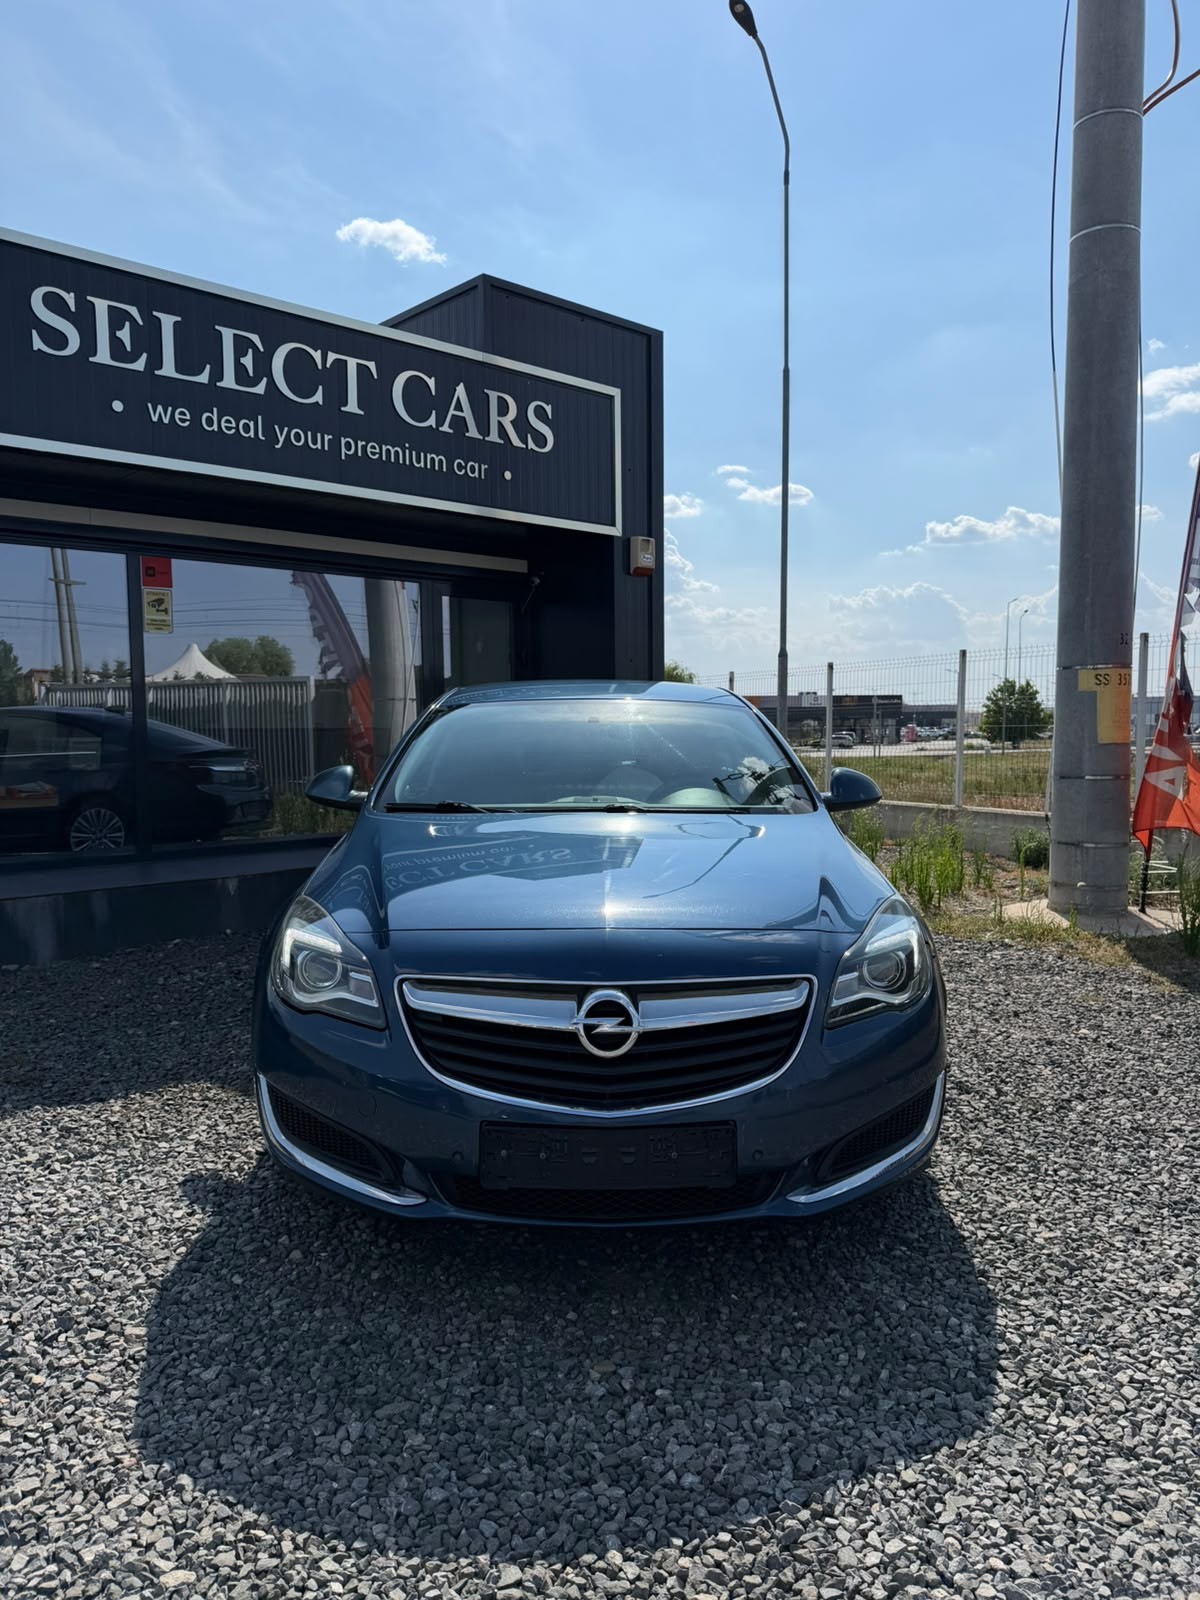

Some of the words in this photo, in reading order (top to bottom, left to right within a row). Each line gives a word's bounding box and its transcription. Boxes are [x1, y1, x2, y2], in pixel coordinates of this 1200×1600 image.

[30, 286, 378, 416] SELECT
[391, 369, 555, 454] CARS
[147, 402, 191, 427] we
[201, 407, 266, 441] deal
[274, 424, 333, 449] your
[340, 435, 448, 472] premium
[453, 457, 489, 481] car
[1094, 673, 1111, 687] SS
